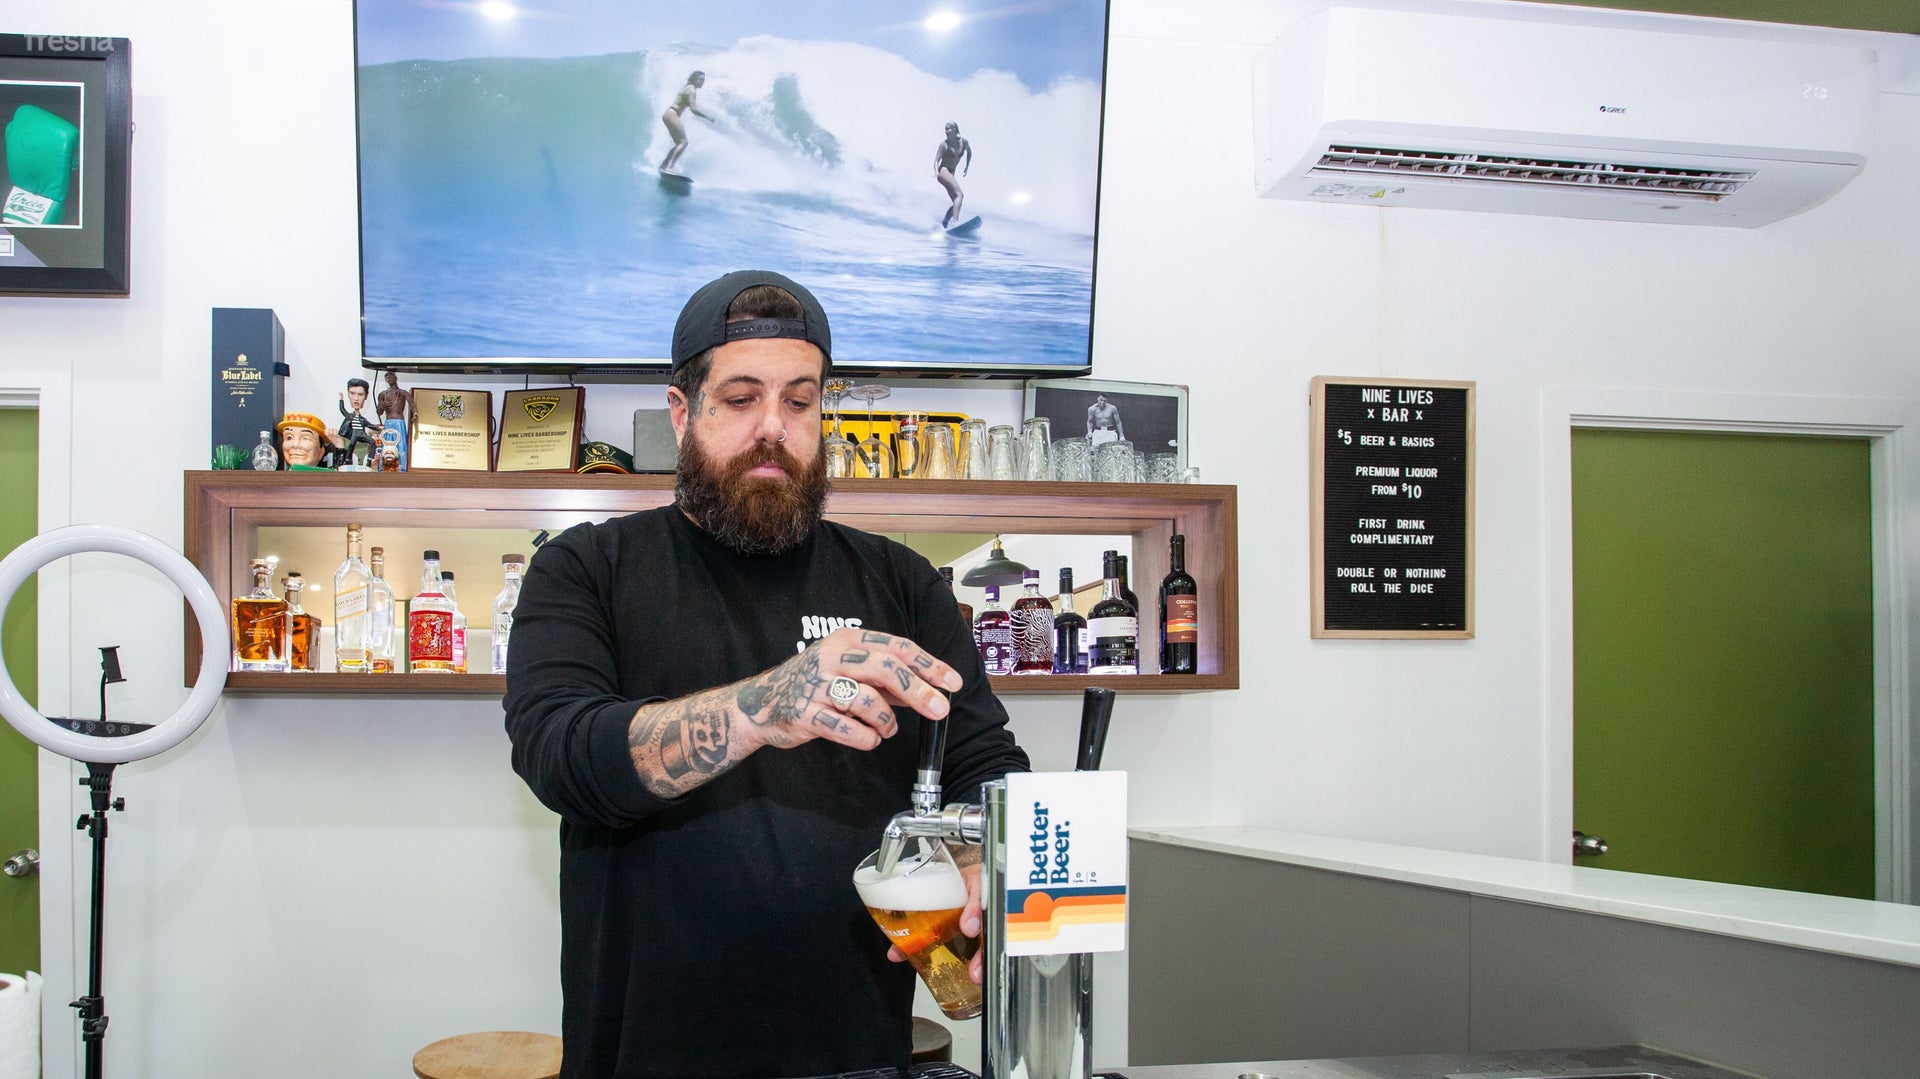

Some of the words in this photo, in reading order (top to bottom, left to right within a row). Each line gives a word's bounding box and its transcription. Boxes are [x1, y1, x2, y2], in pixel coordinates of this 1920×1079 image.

[221, 370, 241, 381] Blue
[241, 370, 262, 381] Label
[1361, 388, 1391, 403] NINE
[1398, 389, 1434, 405] LIVES
[1382, 407, 1409, 422] BAR
[1337, 429, 1352, 445] $5
[1360, 435, 1385, 446] BEER
[1389, 436, 1396, 447] &
[1402, 437, 1435, 448] BASICS
[1355, 466, 1400, 478] PREMIUM
[1405, 467, 1438, 478] LIQUOR
[1371, 485, 1397, 496] FROM
[1402, 482, 1422, 499] $10
[1358, 518, 1387, 529] FIRST
[1397, 519, 1426, 530] DRINK
[1350, 534, 1435, 545] COMPLIMENTARY
[1337, 567, 1375, 578] DOUBLE
[1384, 568, 1397, 578] OR
[1406, 568, 1447, 579] NOTHING
[1351, 583, 1376, 593] ROLL
[1384, 583, 1402, 594] THE
[1410, 583, 1434, 594] DICE
[1029, 801, 1049, 885] Better
[1051, 820, 1070, 885] Beer.
